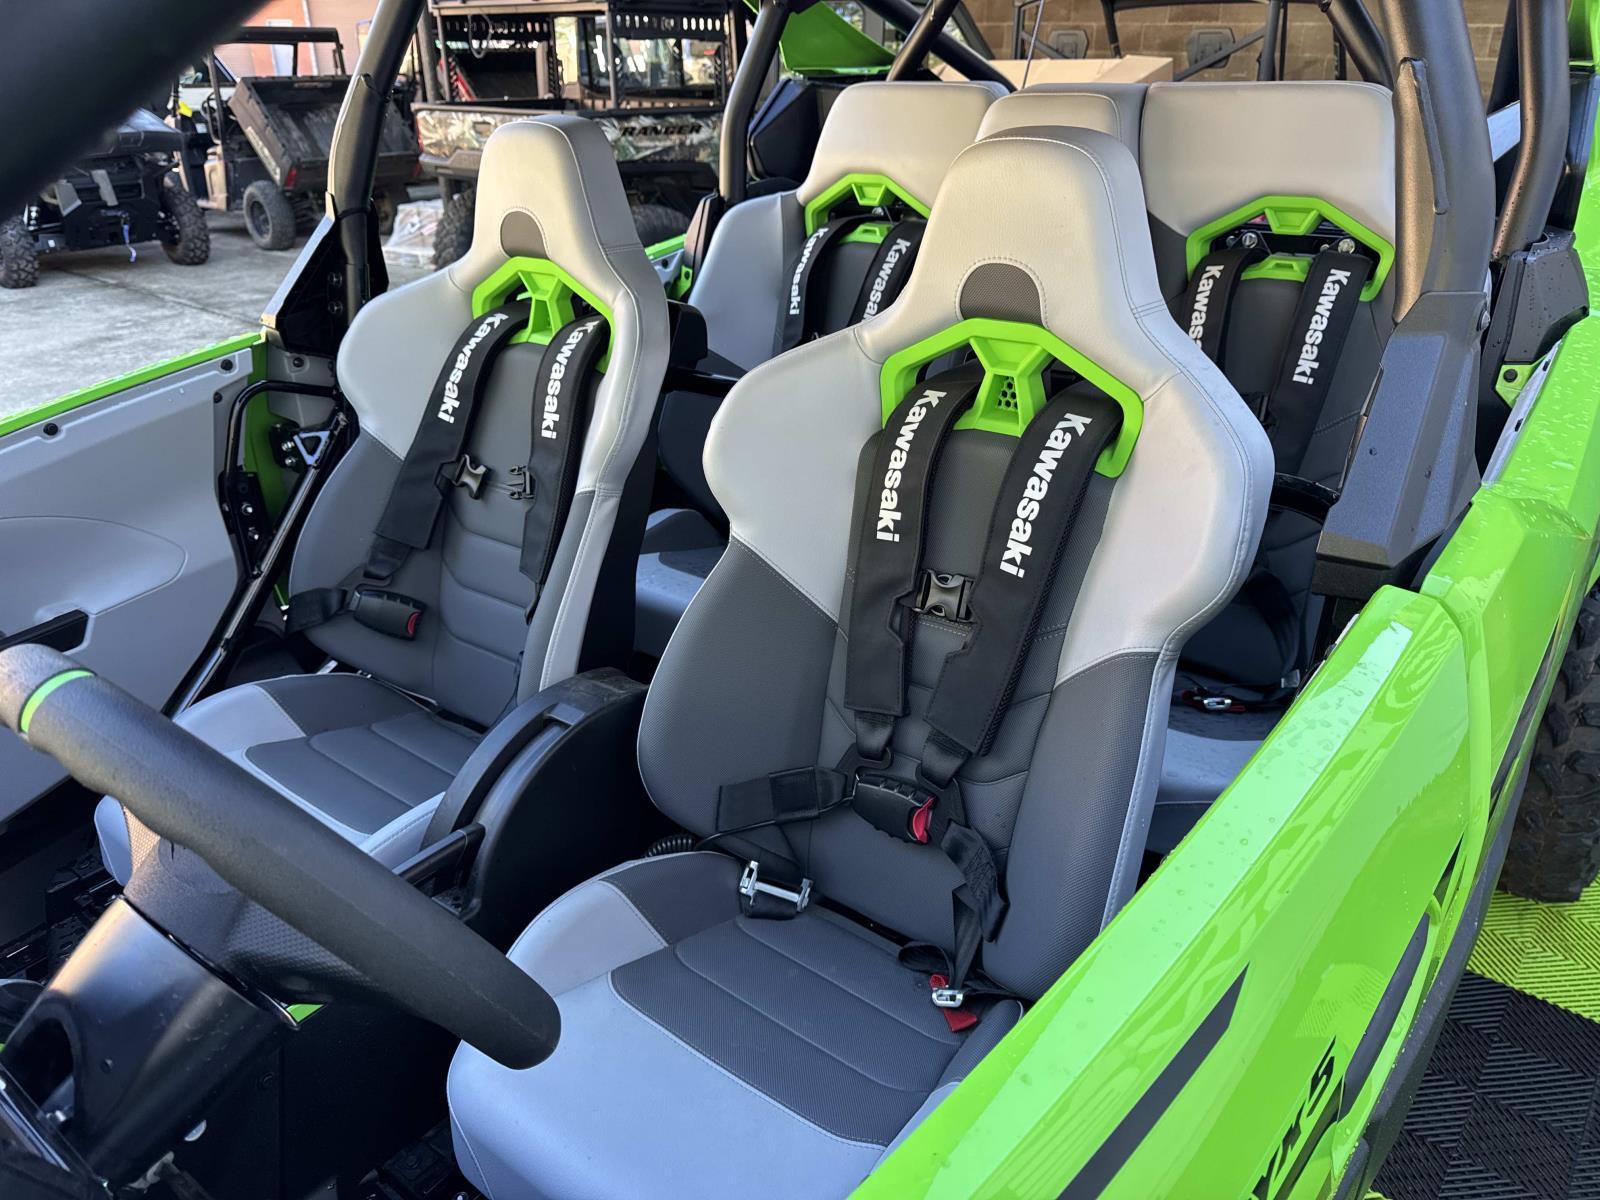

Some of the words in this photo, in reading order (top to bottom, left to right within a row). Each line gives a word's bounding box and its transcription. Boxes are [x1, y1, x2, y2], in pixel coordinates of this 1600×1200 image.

[621, 124, 702, 136] RANGER
[789, 227, 829, 315] Kawasaki
[862, 238, 911, 322] Kawasa
[1189, 265, 1225, 348] Kawas
[1293, 269, 1351, 385] Kawasaki
[437, 313, 509, 424] Kawasaki
[541, 320, 600, 439] Kawasaki
[876, 389, 947, 542] Kawasaki
[1000, 412, 1093, 579] Kawasaki
[1248, 1035, 1335, 1200] YX5
